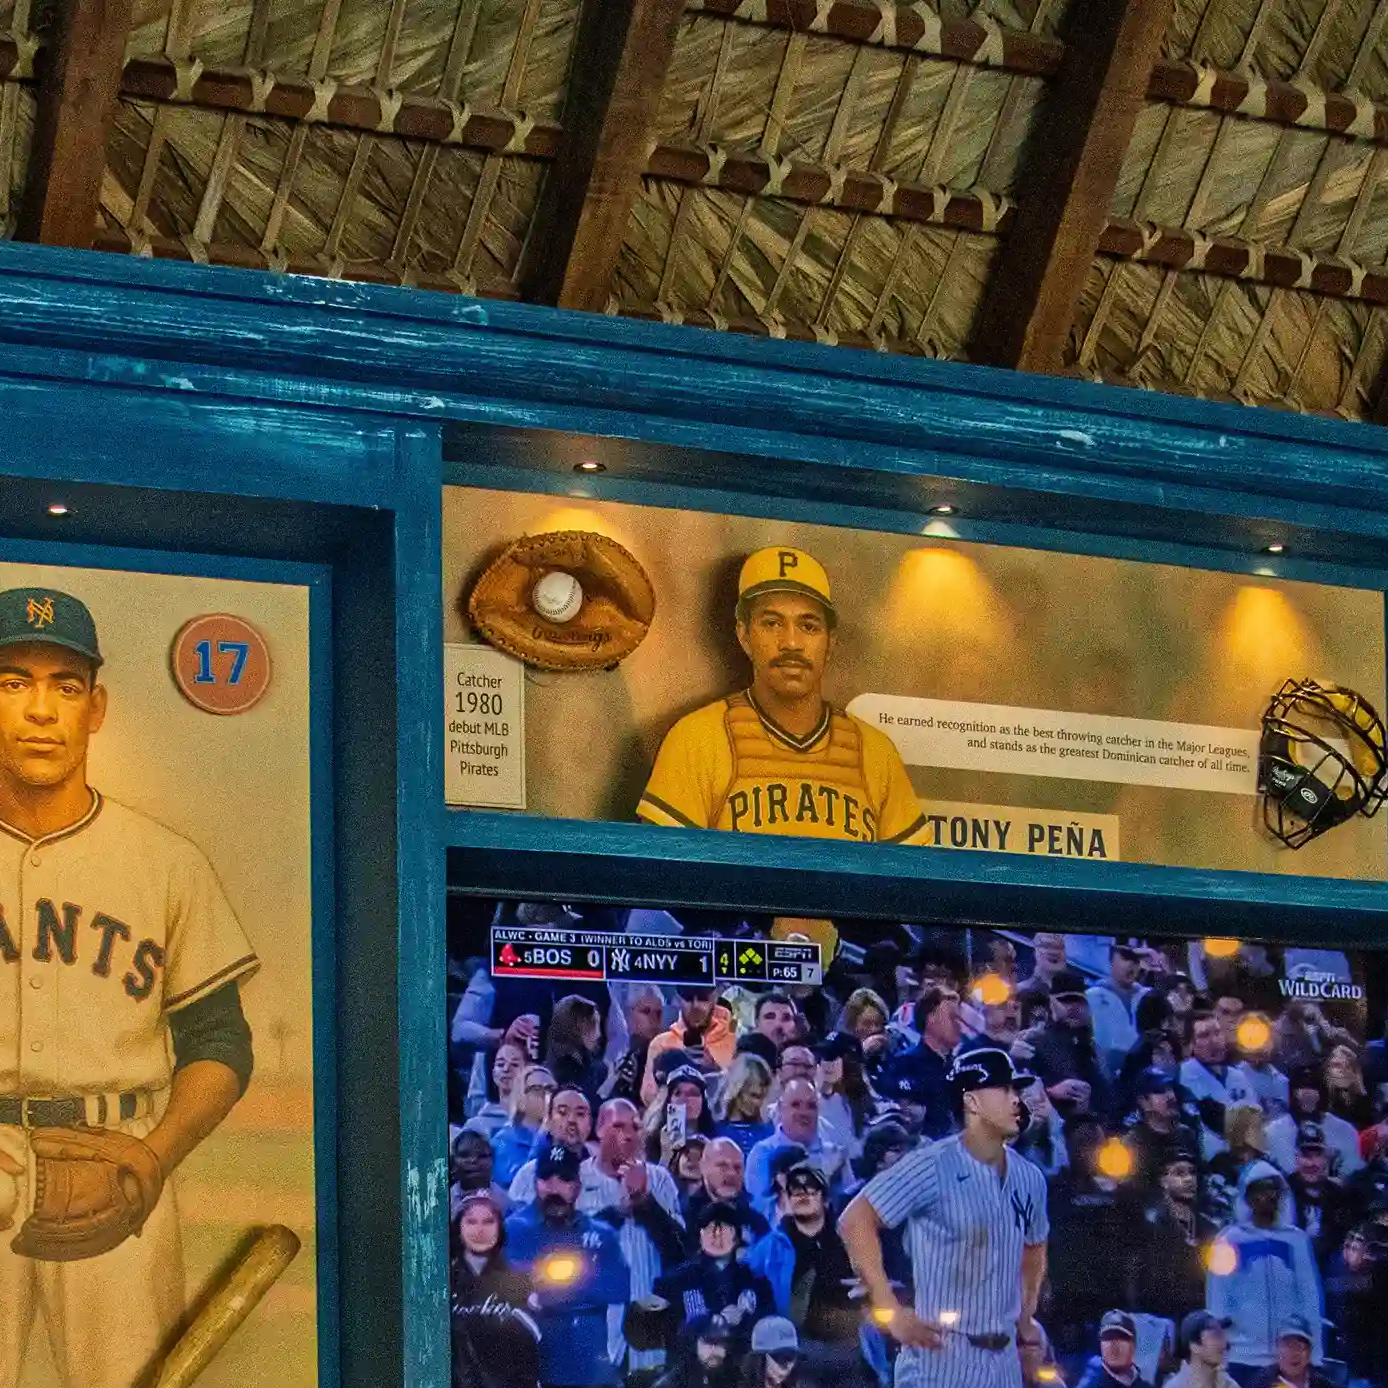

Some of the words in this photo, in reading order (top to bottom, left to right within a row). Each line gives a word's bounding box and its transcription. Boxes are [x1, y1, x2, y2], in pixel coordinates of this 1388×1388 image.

[778, 551, 799, 577] P
[194, 640, 250, 686] 17
[457, 671, 503, 688] Catcher
[456, 692, 503, 715] 1980
[449, 720, 481, 735] debut
[485, 722, 509, 736] MLB
[879, 712, 894, 724] He
[897, 716, 933, 728] earned
[937, 720, 996, 734] recognition
[999, 726, 1010, 735] as
[1013, 725, 1029, 736] the
[1033, 727, 1053, 739] best
[1057, 729, 1103, 745] throwing
[1105, 735, 1141, 748] catcher
[1145, 738, 1155, 749] in
[1158, 738, 1173, 750] the
[1176, 740, 1205, 755] Major
[1209, 743, 1250, 760] Leagues,
[450, 740, 508, 759] Pittsburgh
[967, 738, 987, 749] and
[990, 739, 1023, 752] stands
[1026, 744, 1037, 753] as
[1040, 743, 1056, 755] the
[1059, 746, 1099, 760] greatest
[1103, 749, 1156, 764] Dominican
[1159, 756, 1194, 769] catcher
[1197, 758, 1208, 769] of
[1211, 759, 1223, 771] all
[1225, 762, 1250, 773] time.
[460, 760, 499, 776] Pirates
[728, 782, 877, 842] PIRATES
[927, 815, 1012, 850] TONY
[1027, 820, 1108, 859] PEÑA
[495, 930, 526, 941] ALWC
[535, 932, 567, 943] GAME
[570, 934, 576, 943] 3
[629, 936, 643, 946] TO
[675, 941, 686, 949] vs
[533, 948, 572, 965] BOS
[587, 950, 600, 967] 0
[643, 953, 678, 970] NYY
[699, 955, 708, 973] 1
